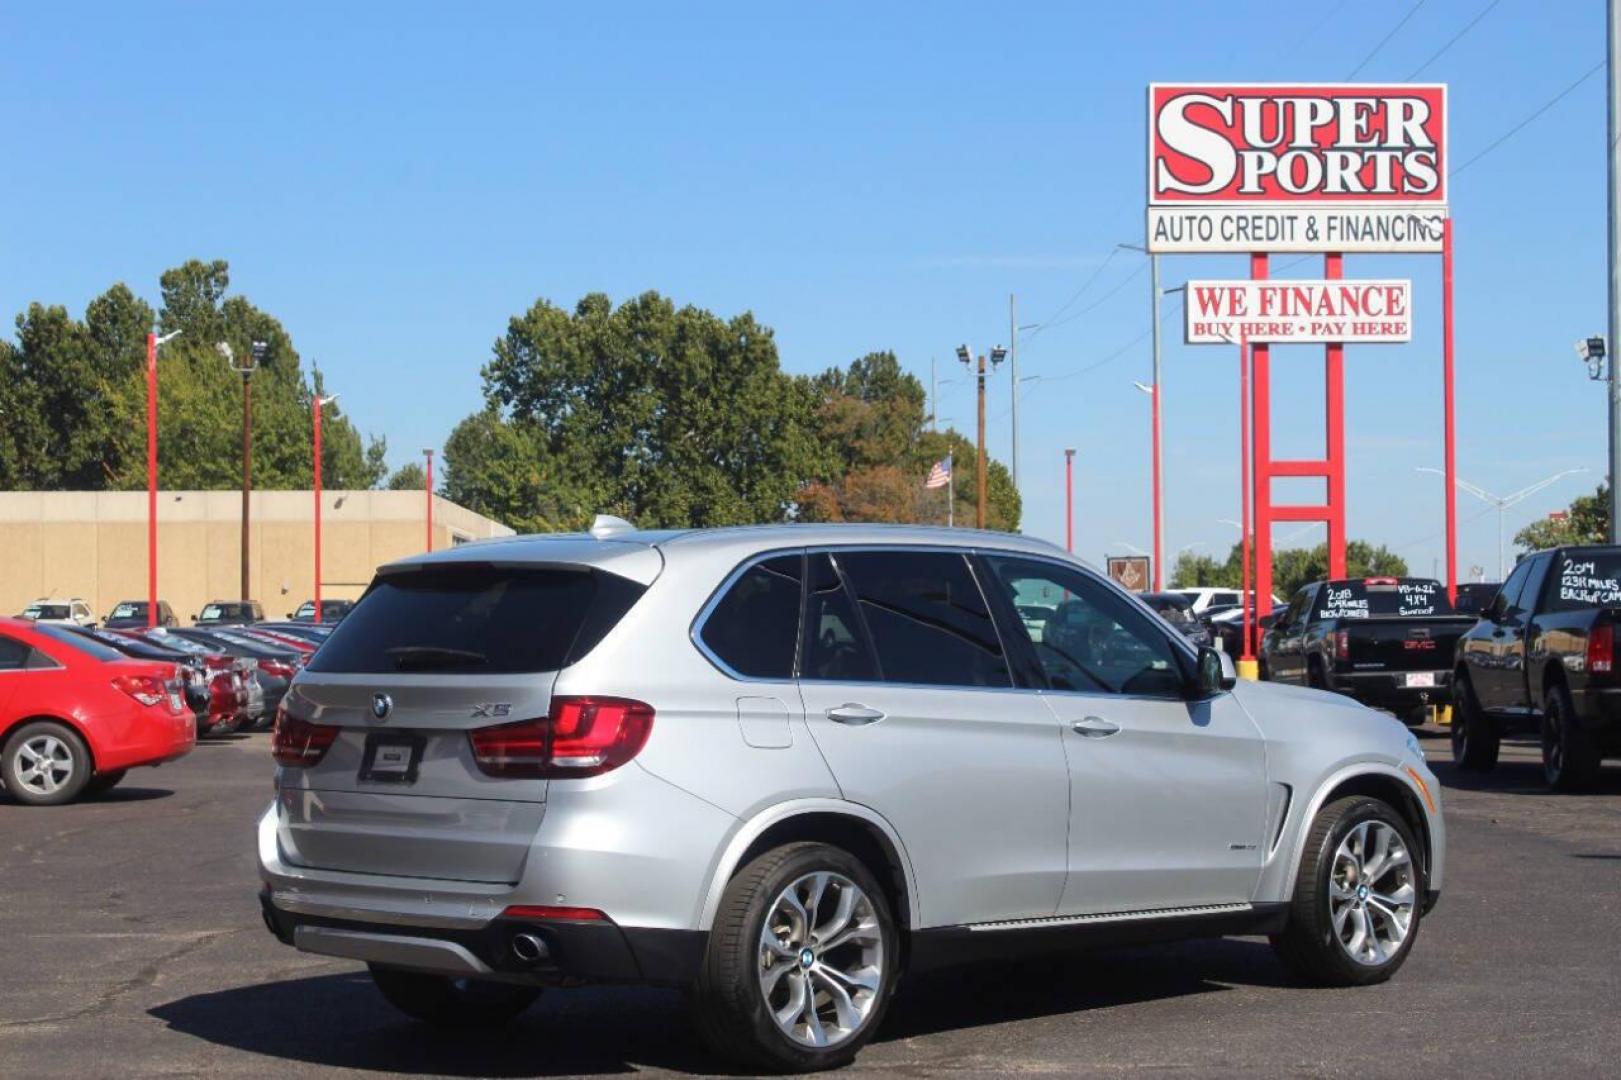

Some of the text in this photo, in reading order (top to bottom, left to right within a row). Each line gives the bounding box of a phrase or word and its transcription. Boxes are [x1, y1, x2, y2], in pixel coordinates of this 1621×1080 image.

[1154, 215, 1213, 242] AUTO
[1220, 215, 1298, 242] CREDIT
[1305, 216, 1319, 242] &
[1195, 286, 1405, 317] WE FINANCE
[1194, 322, 1408, 336] BUY HERE PAY HERE
[471, 703, 512, 718] X5
